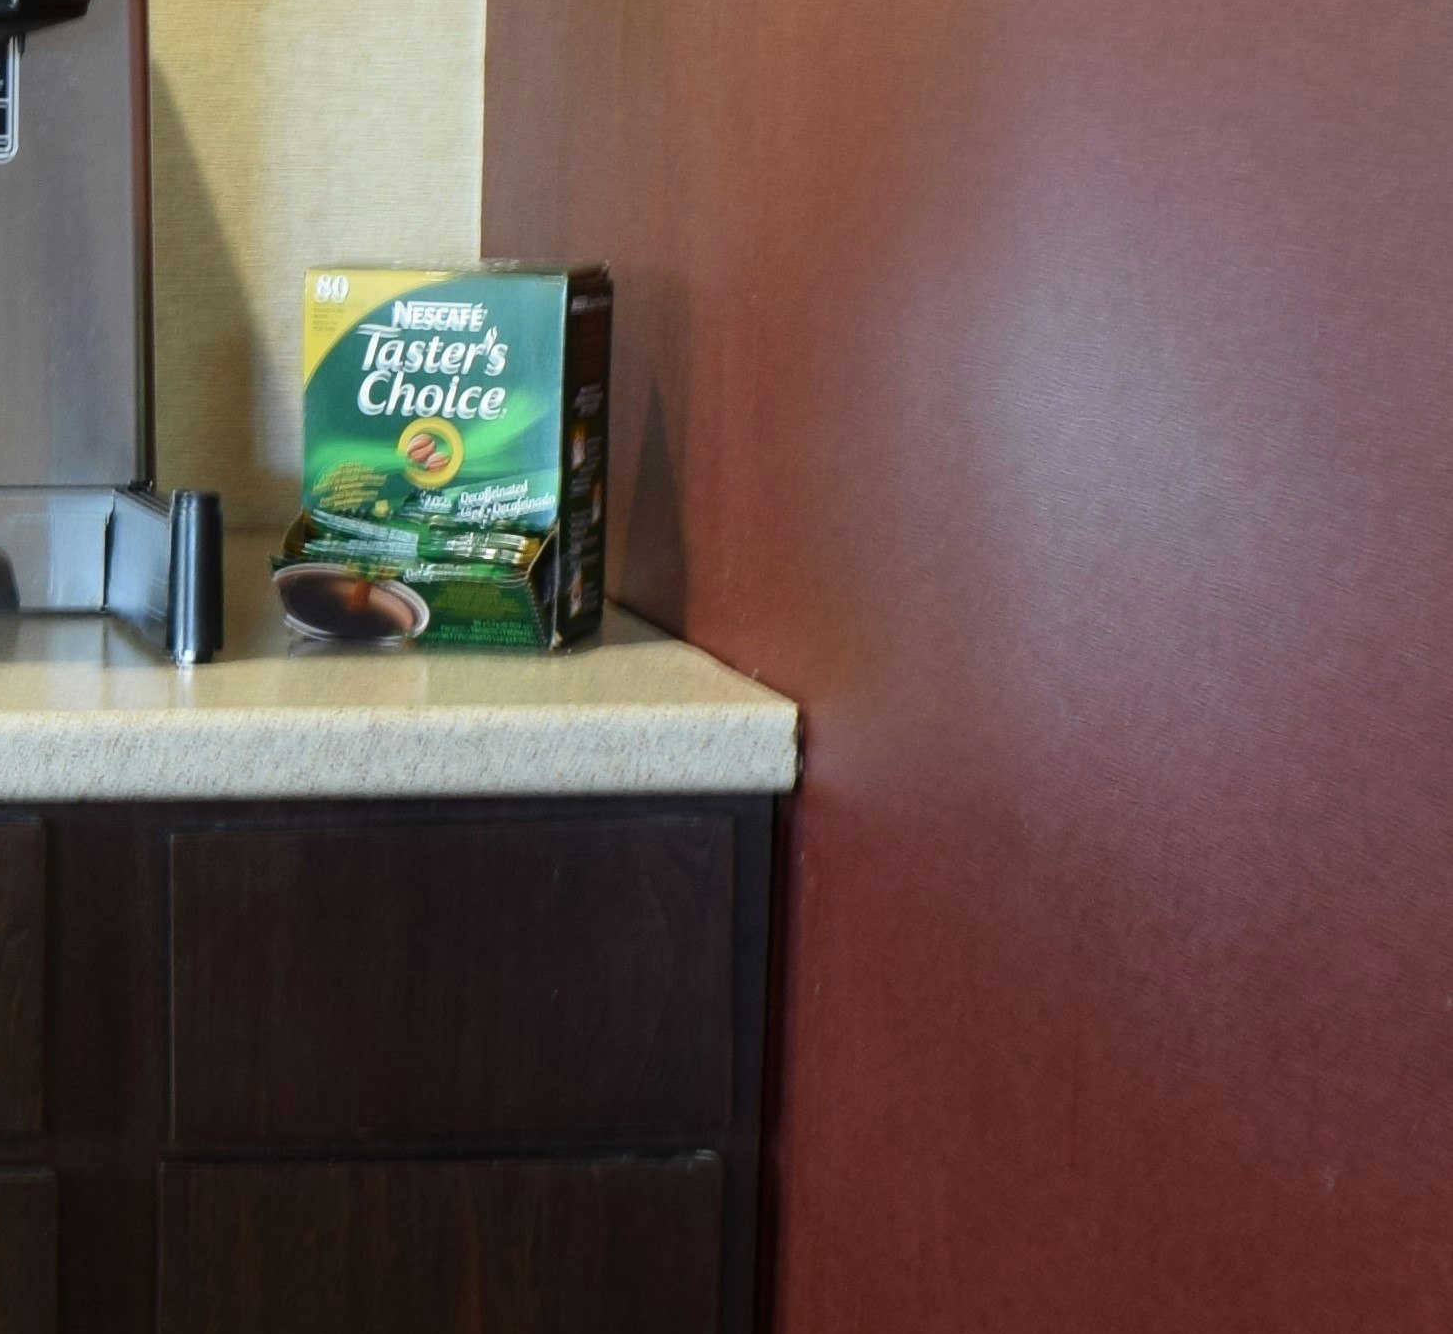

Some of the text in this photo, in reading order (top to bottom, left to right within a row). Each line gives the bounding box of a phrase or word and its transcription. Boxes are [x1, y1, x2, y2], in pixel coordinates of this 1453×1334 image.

[314, 274, 349, 303] 80
[356, 326, 508, 376] Taster's
[357, 369, 505, 420] Choice
